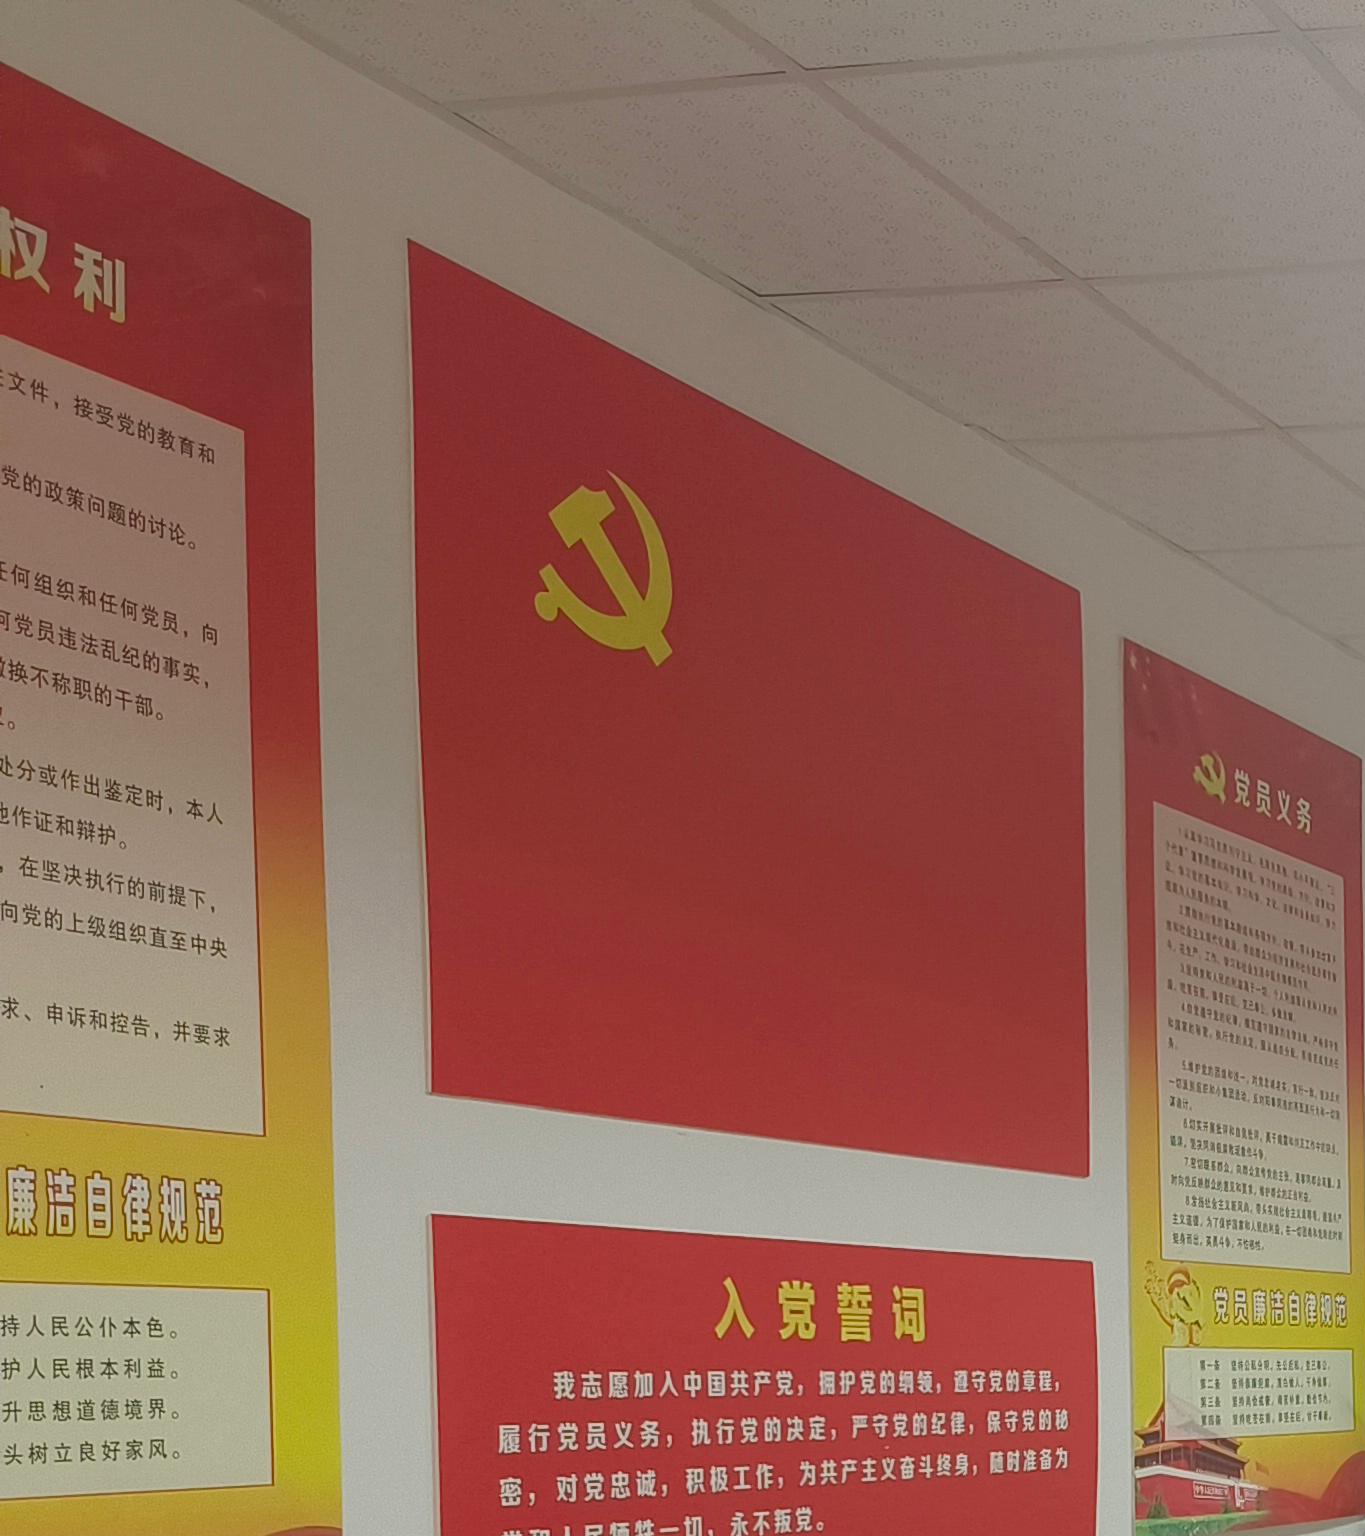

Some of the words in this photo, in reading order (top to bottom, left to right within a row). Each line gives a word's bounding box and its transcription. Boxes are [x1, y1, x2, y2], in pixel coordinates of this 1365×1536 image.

[0, 206, 126, 324] 权利
[0, 369, 215, 465] 文件，接受党的教育和
[1, 464, 196, 550] 党的政策问题的讨论。
[0, 657, 164, 721] 换不称职的干部。
[1234, 768, 1313, 834] 党员义务
[1, 900, 228, 958] 向党的上级组织直至中央
[1, 997, 231, 1047] 求、申诉和控告，并要求
[6, 1165, 224, 1244] 廉洁自律规范
[0, 1314, 178, 1339] 持人民公仆本色。
[714, 1276, 928, 1343] 入党誓词
[1213, 1287, 1349, 1329] 党员廉洁自律规范
[1, 1357, 179, 1380] 护人民根本利益。
[552, 1368, 1062, 1401] 我志愿加入中国共产党，拥护党的纲领，遵守党的章程，
[2, 1397, 180, 1422] 升思想道德境界。
[498, 1408, 1069, 1454] 履行党员义务，执行党的决定，严守党的纪律，保守党的秘
[4, 1438, 180, 1465] 头树立良好家风。
[498, 1446, 1069, 1508] 密，对党忠诚，积极工作，为共产主义奋斗终身，随时准备为
